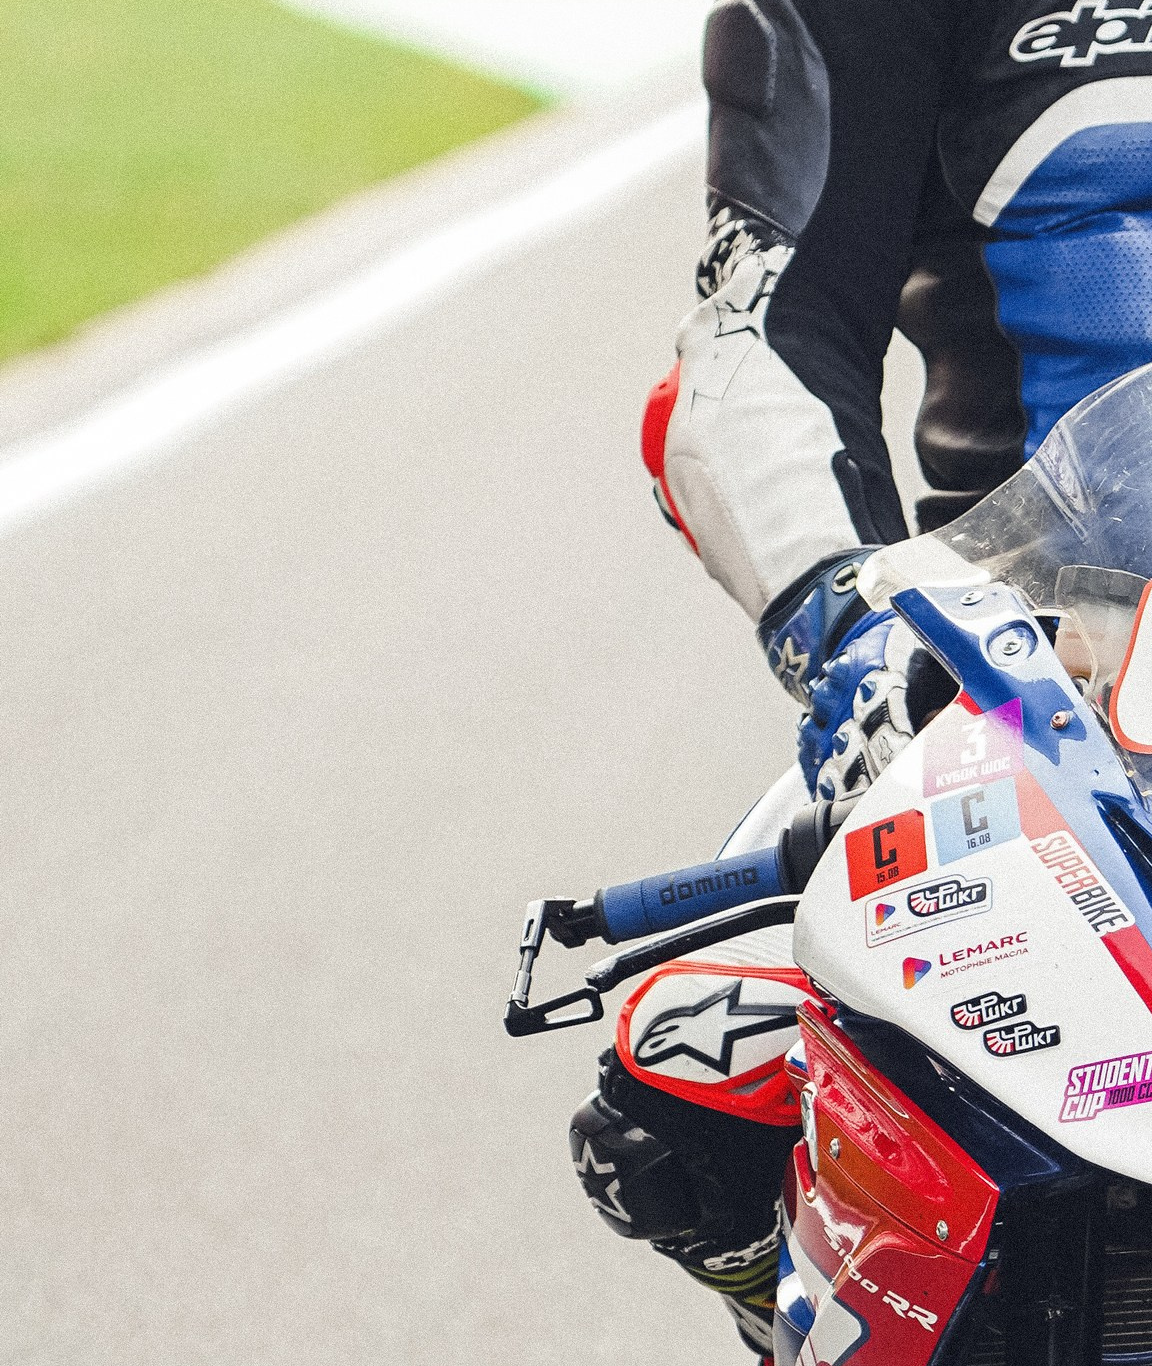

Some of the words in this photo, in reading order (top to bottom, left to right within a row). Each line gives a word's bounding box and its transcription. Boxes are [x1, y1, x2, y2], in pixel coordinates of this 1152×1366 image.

[960, 719, 988, 764] 3
[935, 766, 978, 788] КУБОК
[966, 831, 991, 850] 16.08
[659, 863, 759, 907] domino
[876, 866, 899, 884] 15.08
[1031, 835, 1129, 933] SUPERBIKE
[870, 922, 902, 936] LEMARC
[938, 931, 1028, 966] LEMARC
[940, 958, 992, 979] МОТОРНЫЕ
[994, 947, 1029, 962] МАСЛА
[1061, 1091, 1106, 1121] CUP
[1108, 1086, 1135, 1106] 1000
[882, 1290, 939, 1332] RR
